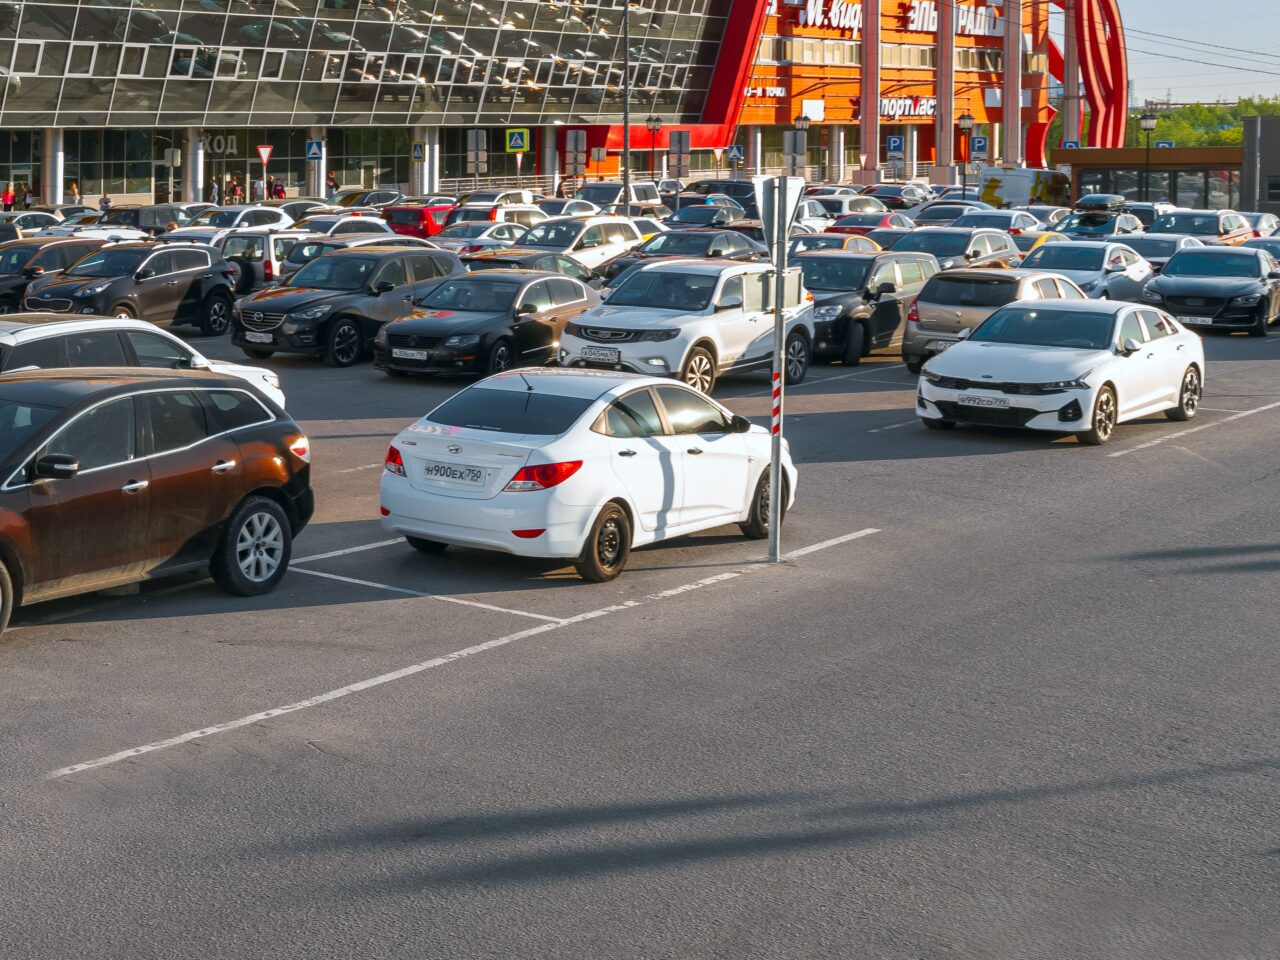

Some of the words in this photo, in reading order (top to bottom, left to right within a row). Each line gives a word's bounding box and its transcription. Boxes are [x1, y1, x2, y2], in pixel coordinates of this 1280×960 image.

[204, 135, 238, 155] ХОД
[890, 138, 900, 150] P
[975, 138, 985, 150] P
